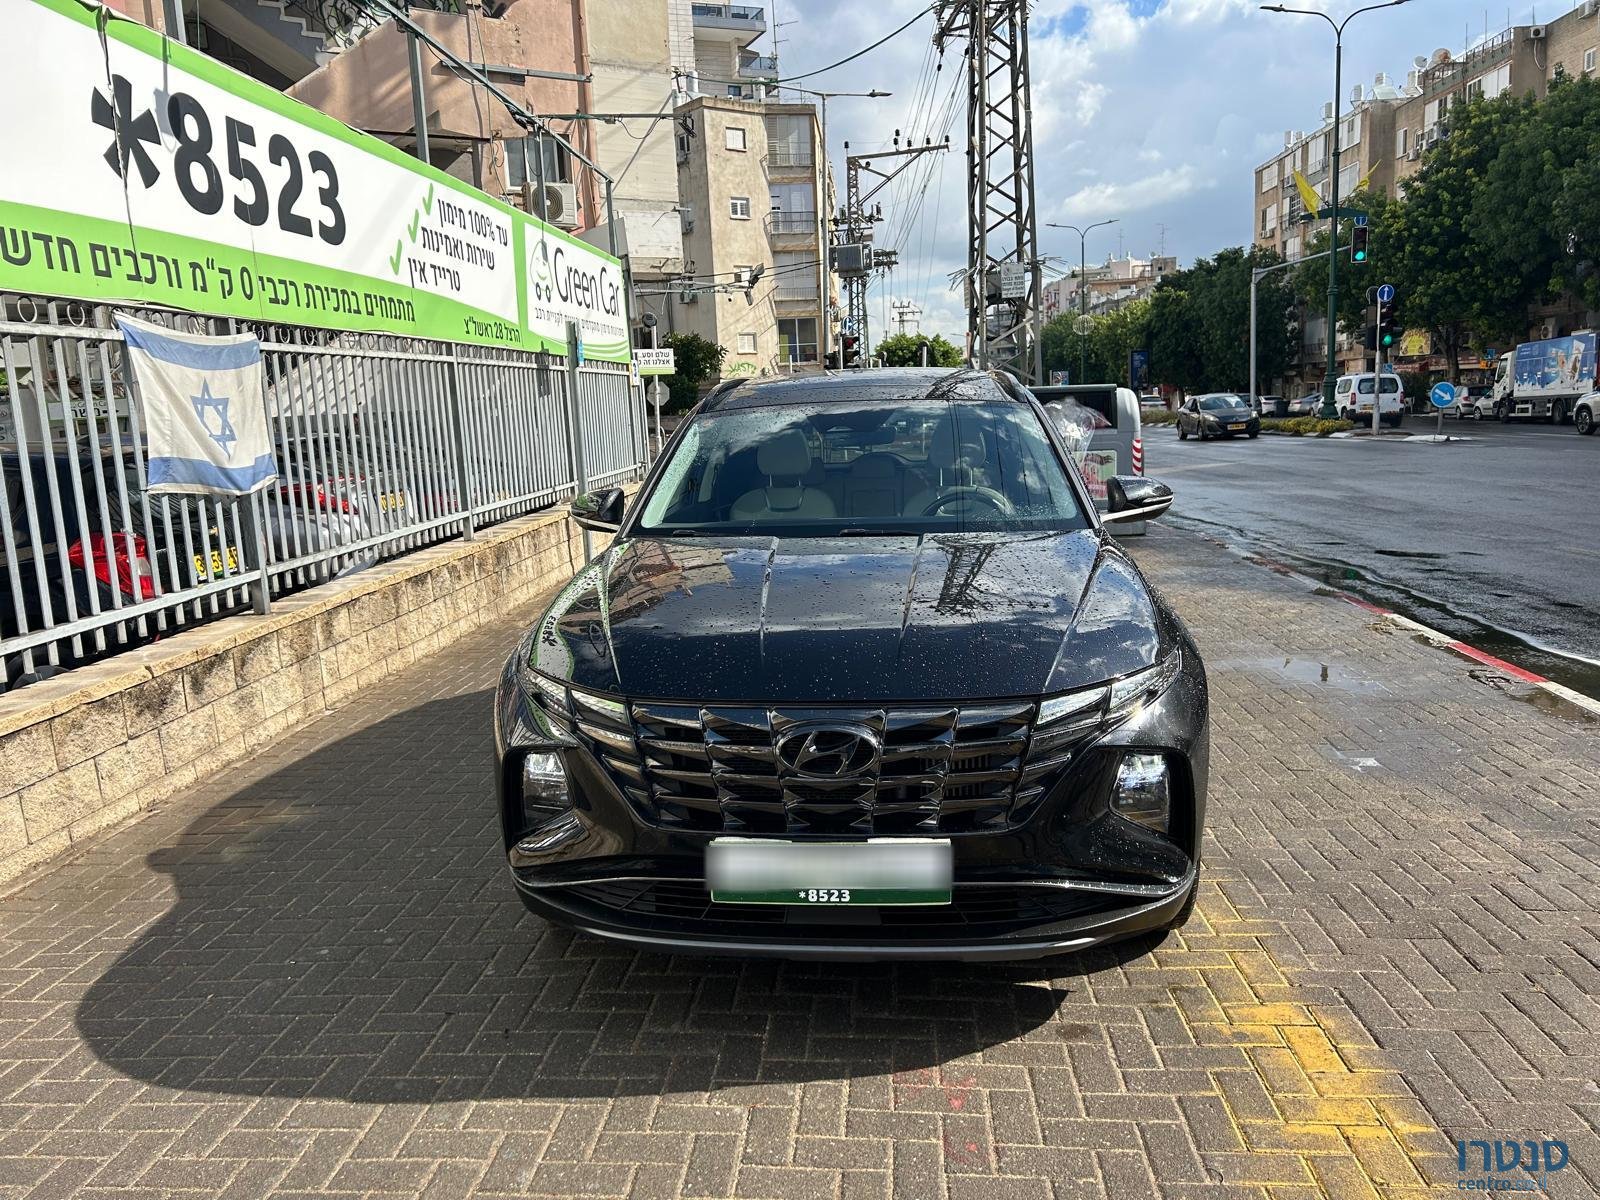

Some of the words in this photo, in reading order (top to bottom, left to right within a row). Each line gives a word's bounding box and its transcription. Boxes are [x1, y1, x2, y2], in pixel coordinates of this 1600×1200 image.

[437, 198, 466, 229] מימון
[468, 209, 495, 241] 100%
[421, 226, 464, 260] ואמינות
[496, 225, 508, 246] עד
[89, 242, 182, 288] ורכבים
[466, 242, 495, 270] שירות
[239, 266, 254, 300] 0
[408, 257, 428, 288] אין
[430, 263, 460, 291] טרייד
[554, 247, 599, 311] Green
[599, 266, 619, 317] Car
[258, 275, 301, 307] רכבי
[304, 282, 362, 315] במכירת
[363, 293, 416, 322] מתמחים
[494, 321, 503, 340] 28
[504, 323, 520, 343] הרצל
